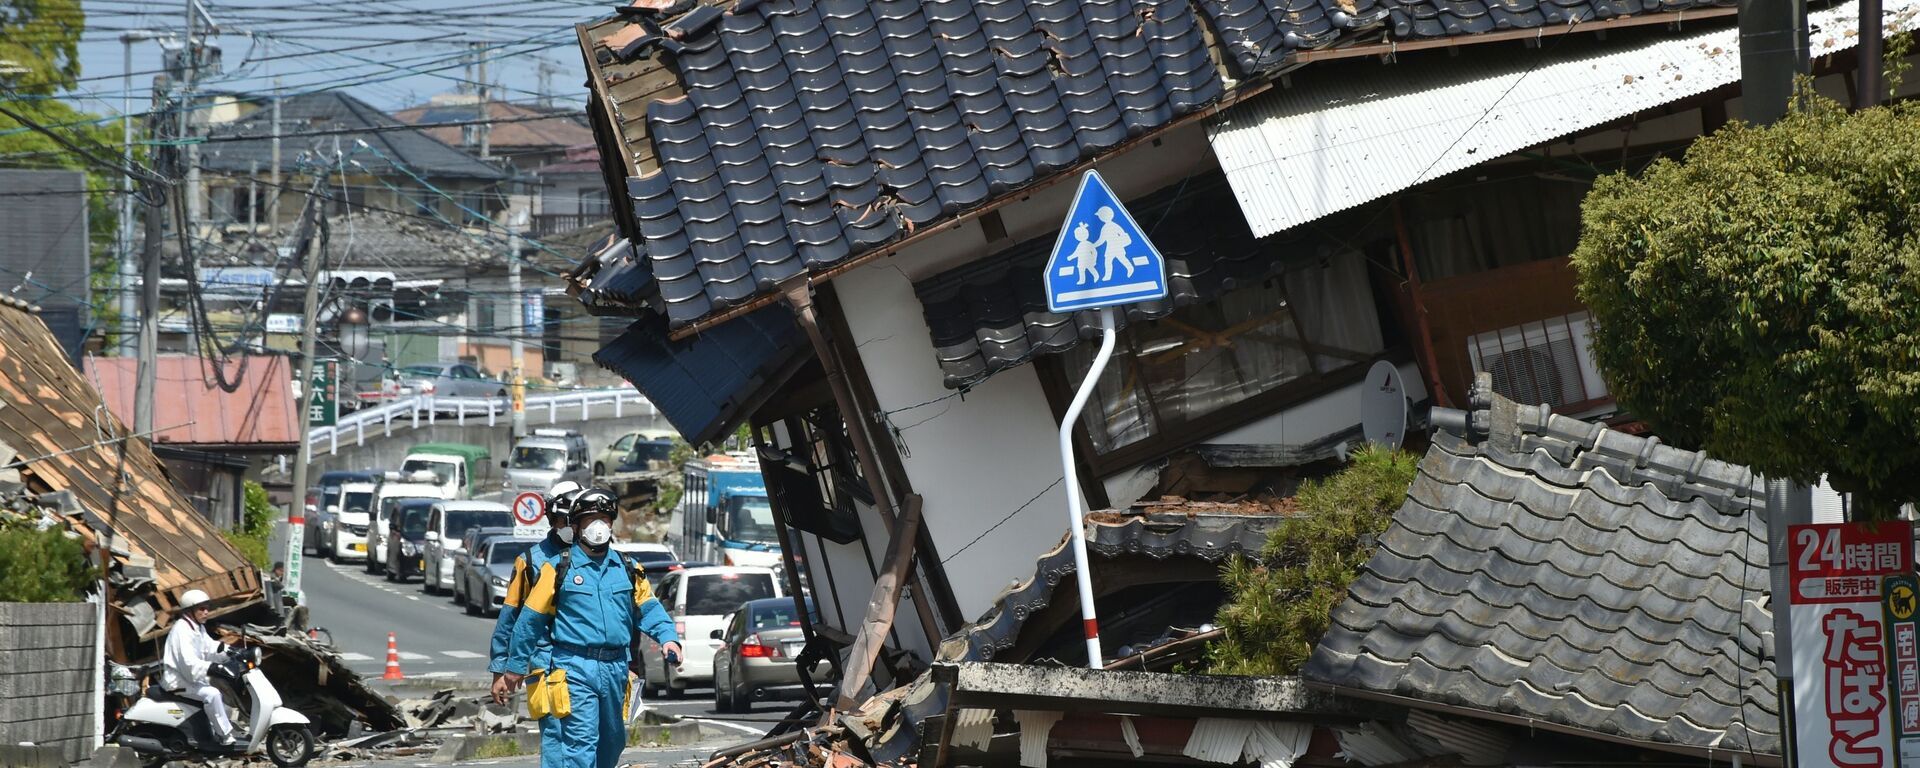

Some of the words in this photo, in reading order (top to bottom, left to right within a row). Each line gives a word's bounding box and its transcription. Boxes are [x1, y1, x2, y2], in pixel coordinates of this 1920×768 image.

[1797, 528, 1902, 571] 24時間
[1825, 577, 1877, 596] 販売中
[1823, 608, 1885, 768] たばこ
[1897, 626, 1920, 730] 宅急便
